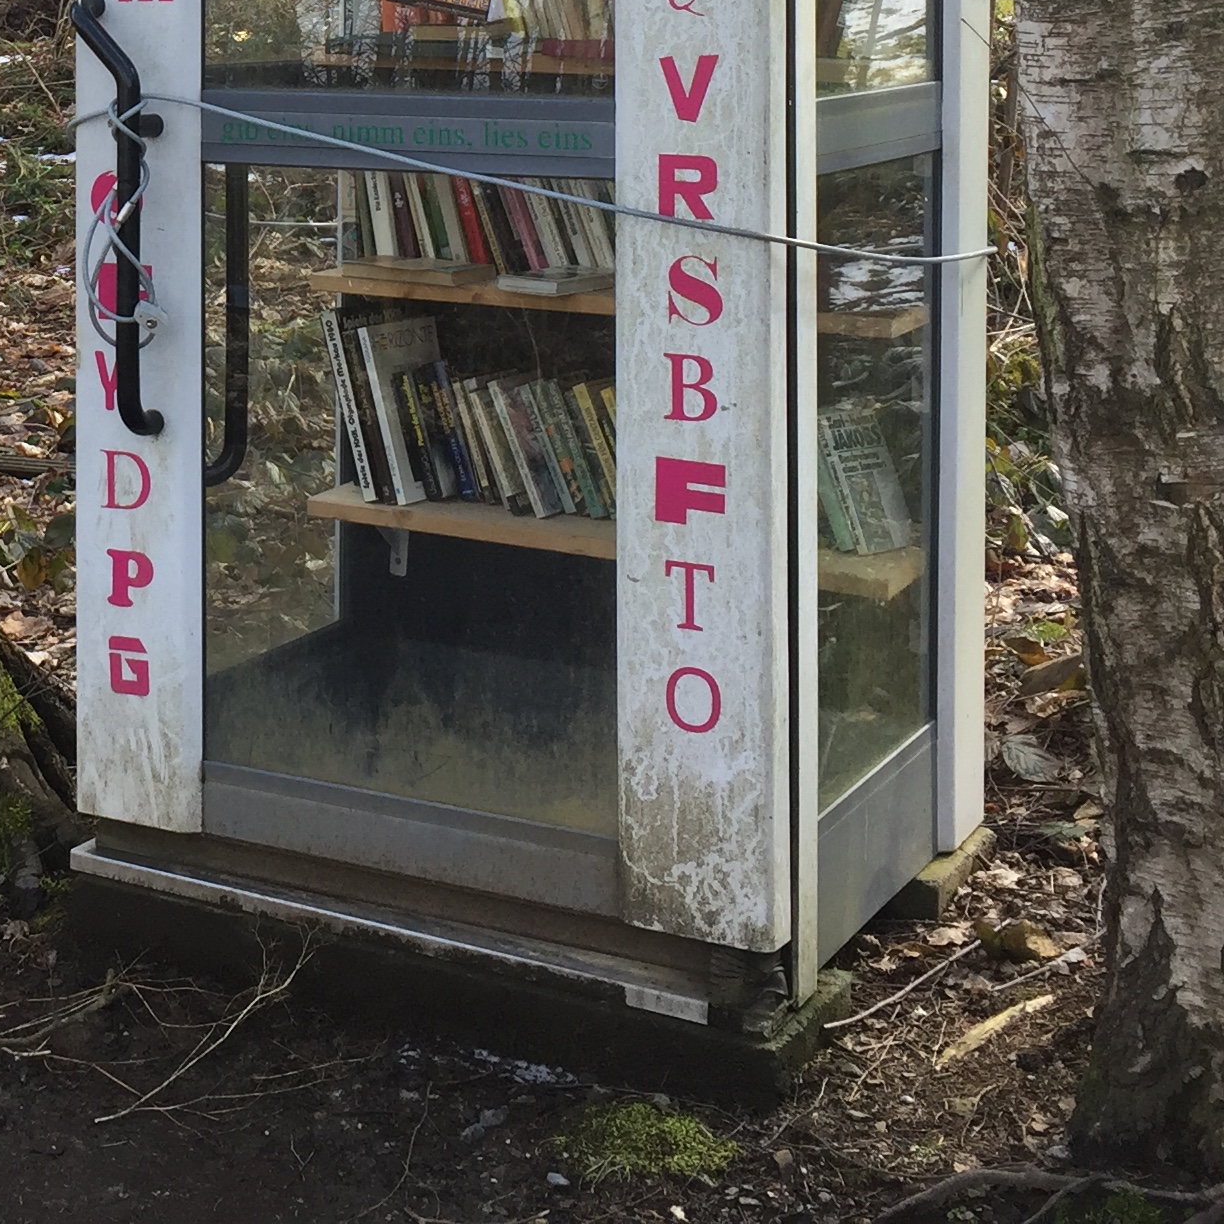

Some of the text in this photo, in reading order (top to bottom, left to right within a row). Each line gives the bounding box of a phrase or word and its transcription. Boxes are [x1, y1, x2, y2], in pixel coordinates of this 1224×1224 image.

[332, 119, 405, 146] nimm
[483, 120, 529, 149] lies
[537, 121, 594, 152] eins
[324, 318, 337, 342] 1980
[354, 448, 364, 463] der
